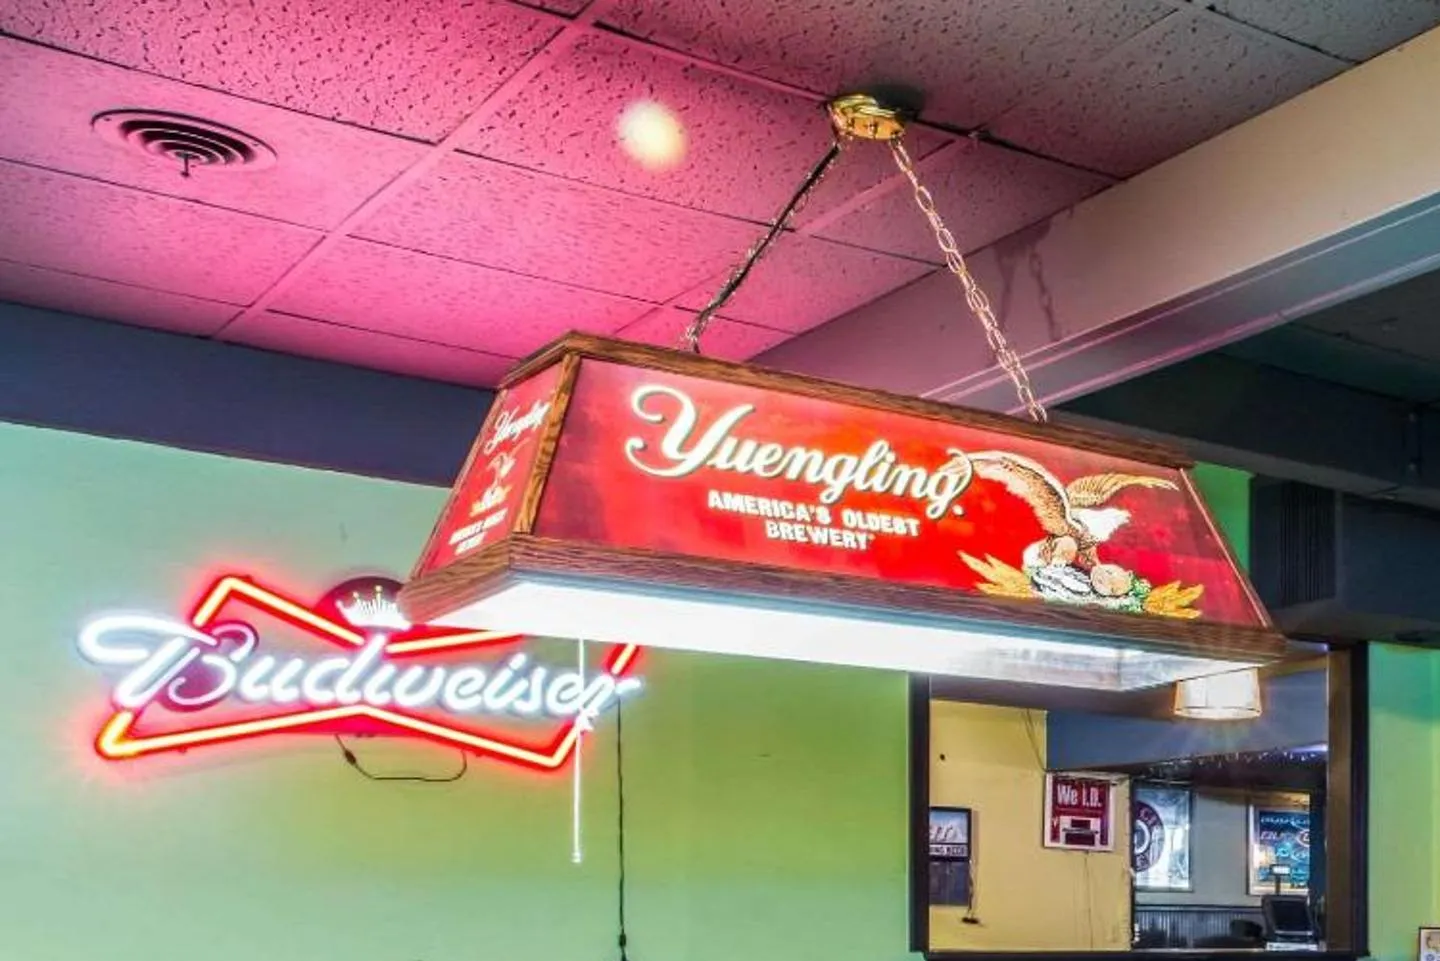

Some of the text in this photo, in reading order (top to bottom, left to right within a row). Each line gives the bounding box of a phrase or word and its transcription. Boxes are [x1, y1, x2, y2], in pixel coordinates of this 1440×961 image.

[625, 385, 974, 520] Yuengling
[708, 489, 921, 537] AMERICA'S OLDEST
[765, 520, 869, 550] BREWERY
[78, 612, 641, 716] Budweiser
[1057, 783, 1078, 806] We
